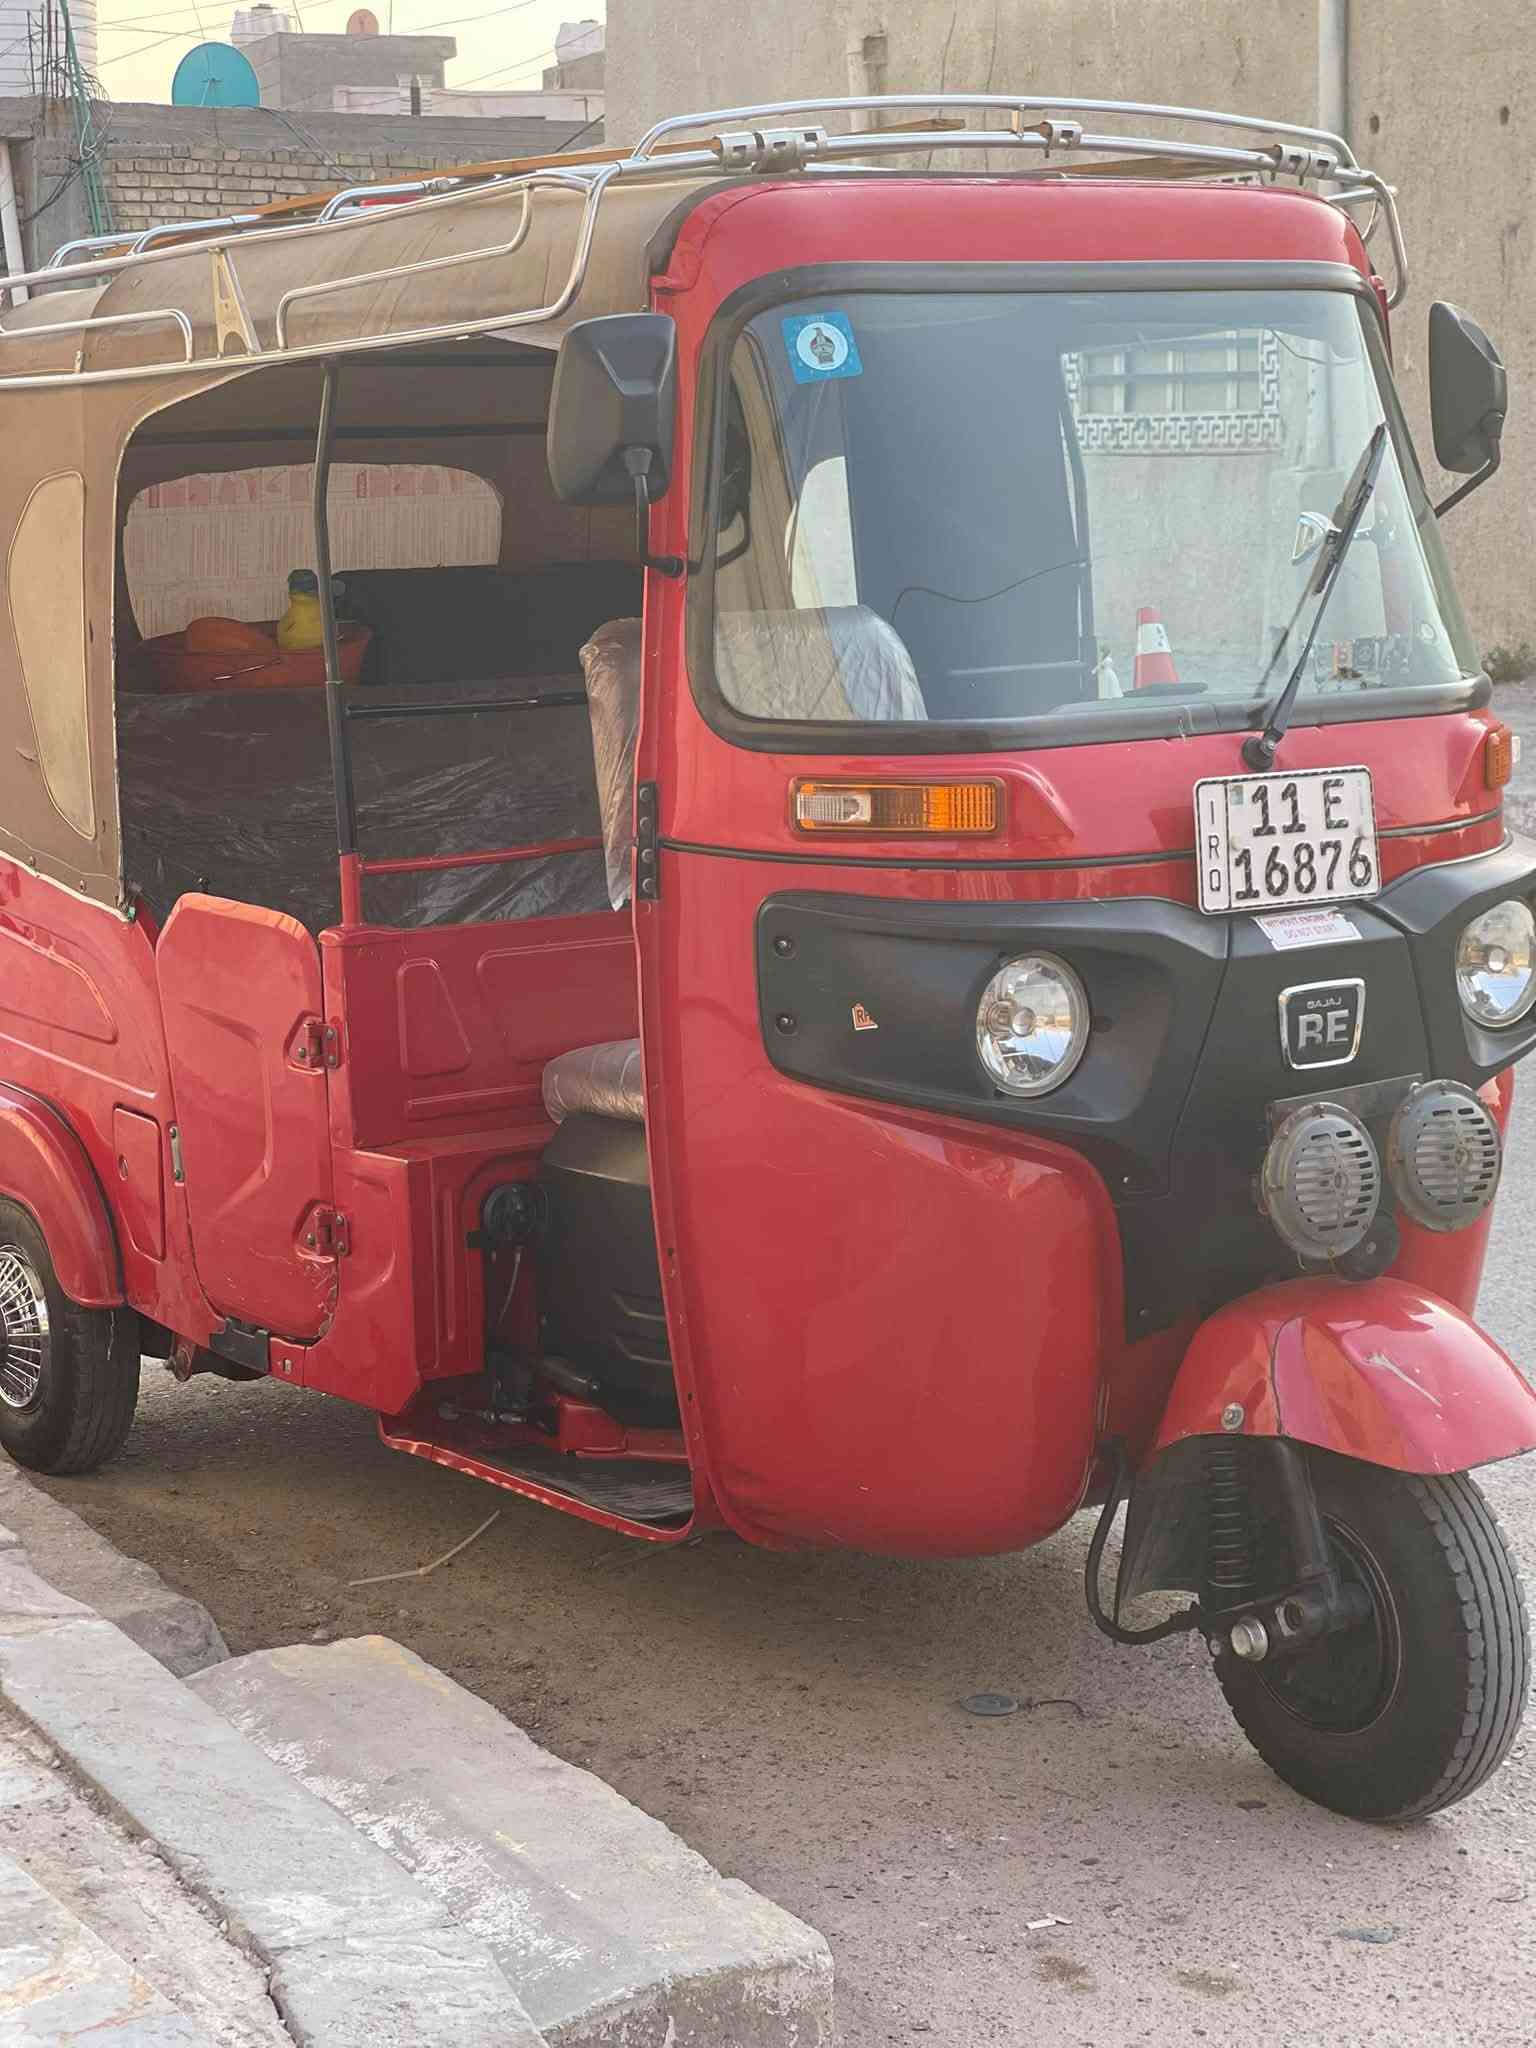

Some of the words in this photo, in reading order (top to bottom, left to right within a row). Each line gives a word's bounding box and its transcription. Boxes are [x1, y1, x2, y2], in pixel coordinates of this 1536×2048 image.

[1251, 782, 1306, 837] 11
[1323, 778, 1349, 830] E
[1234, 836, 1372, 900] 16876
[1298, 1009, 1349, 1049] RE
